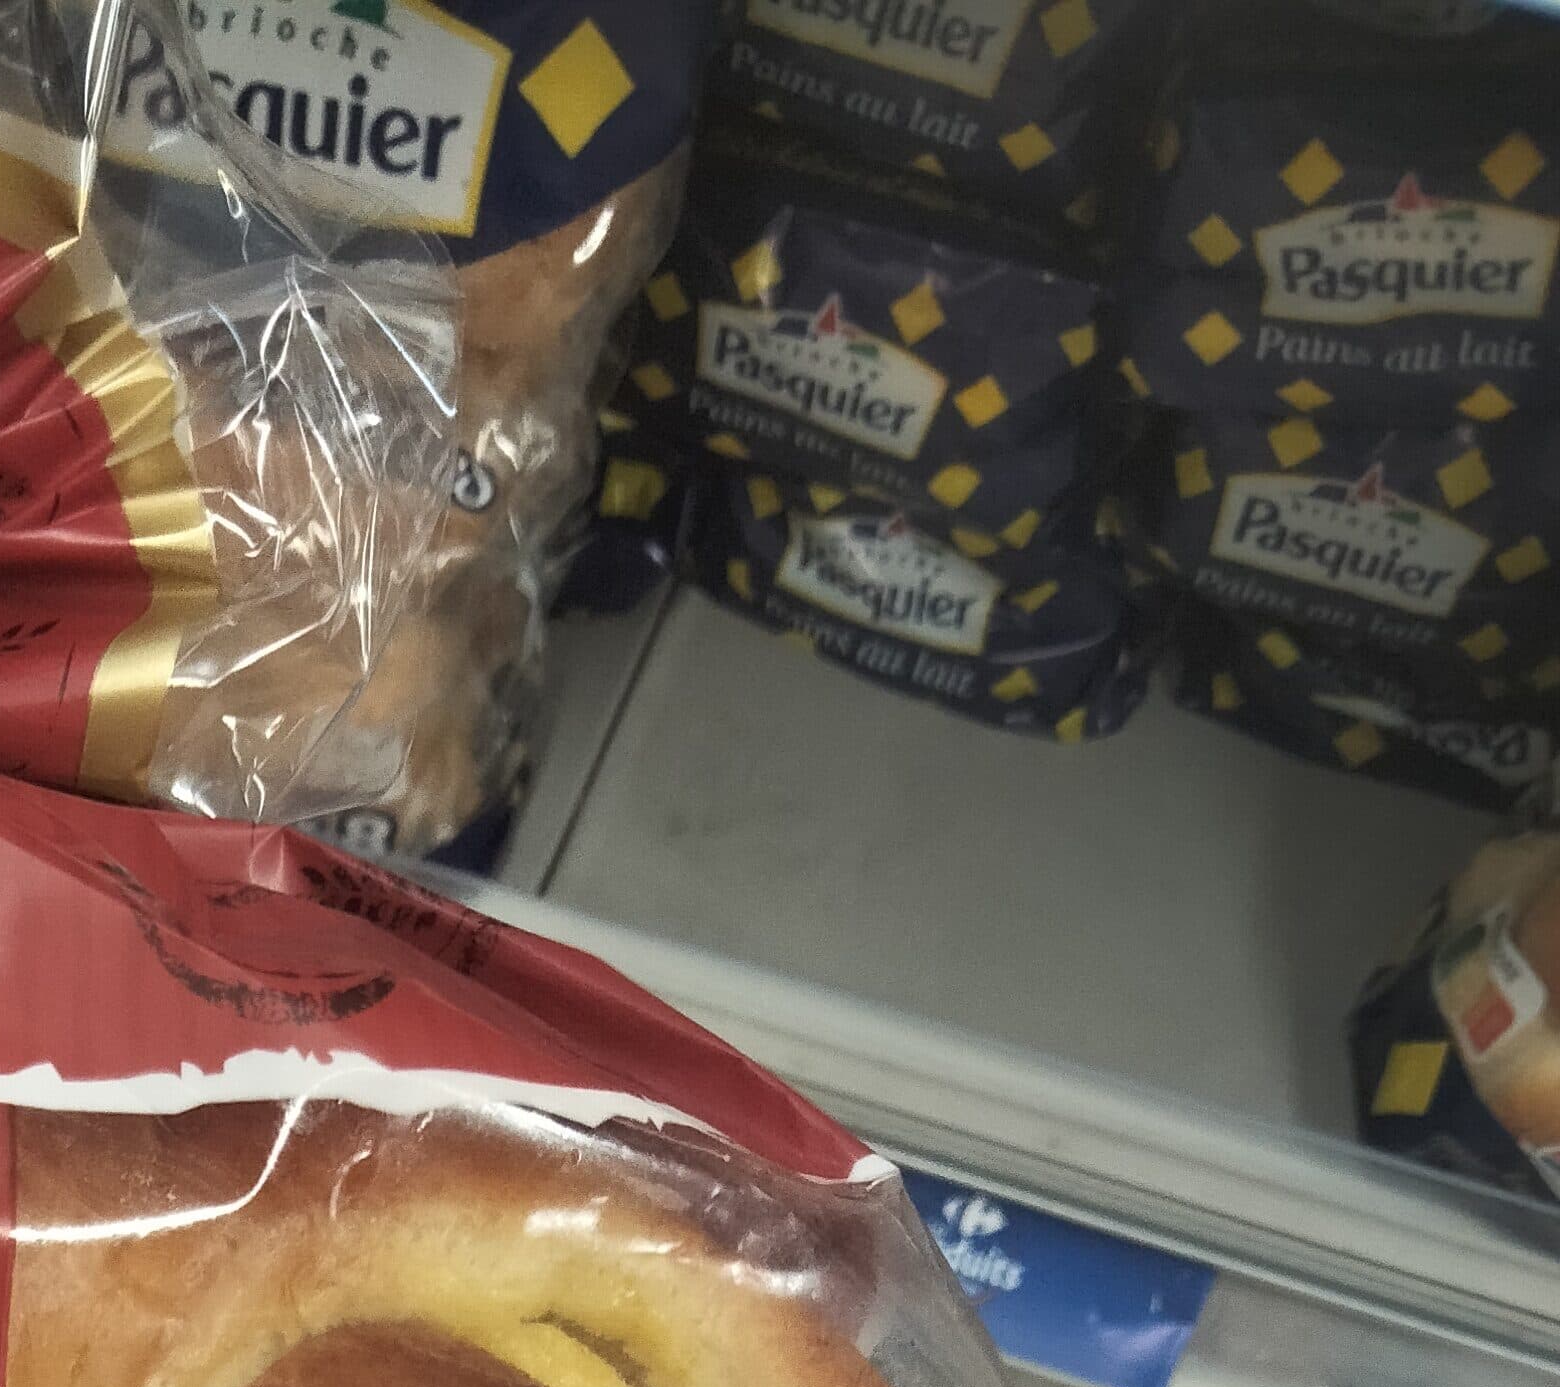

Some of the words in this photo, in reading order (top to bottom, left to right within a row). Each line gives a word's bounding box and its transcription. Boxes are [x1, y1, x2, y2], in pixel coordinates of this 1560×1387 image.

[188, 2, 391, 71] brioche
[769, 0, 999, 64] asquier
[116, 16, 463, 181] Paquier
[1280, 246, 1533, 302] Pasquier
[714, 325, 916, 436] Pasquier
[1233, 496, 1454, 599] Pasquier
